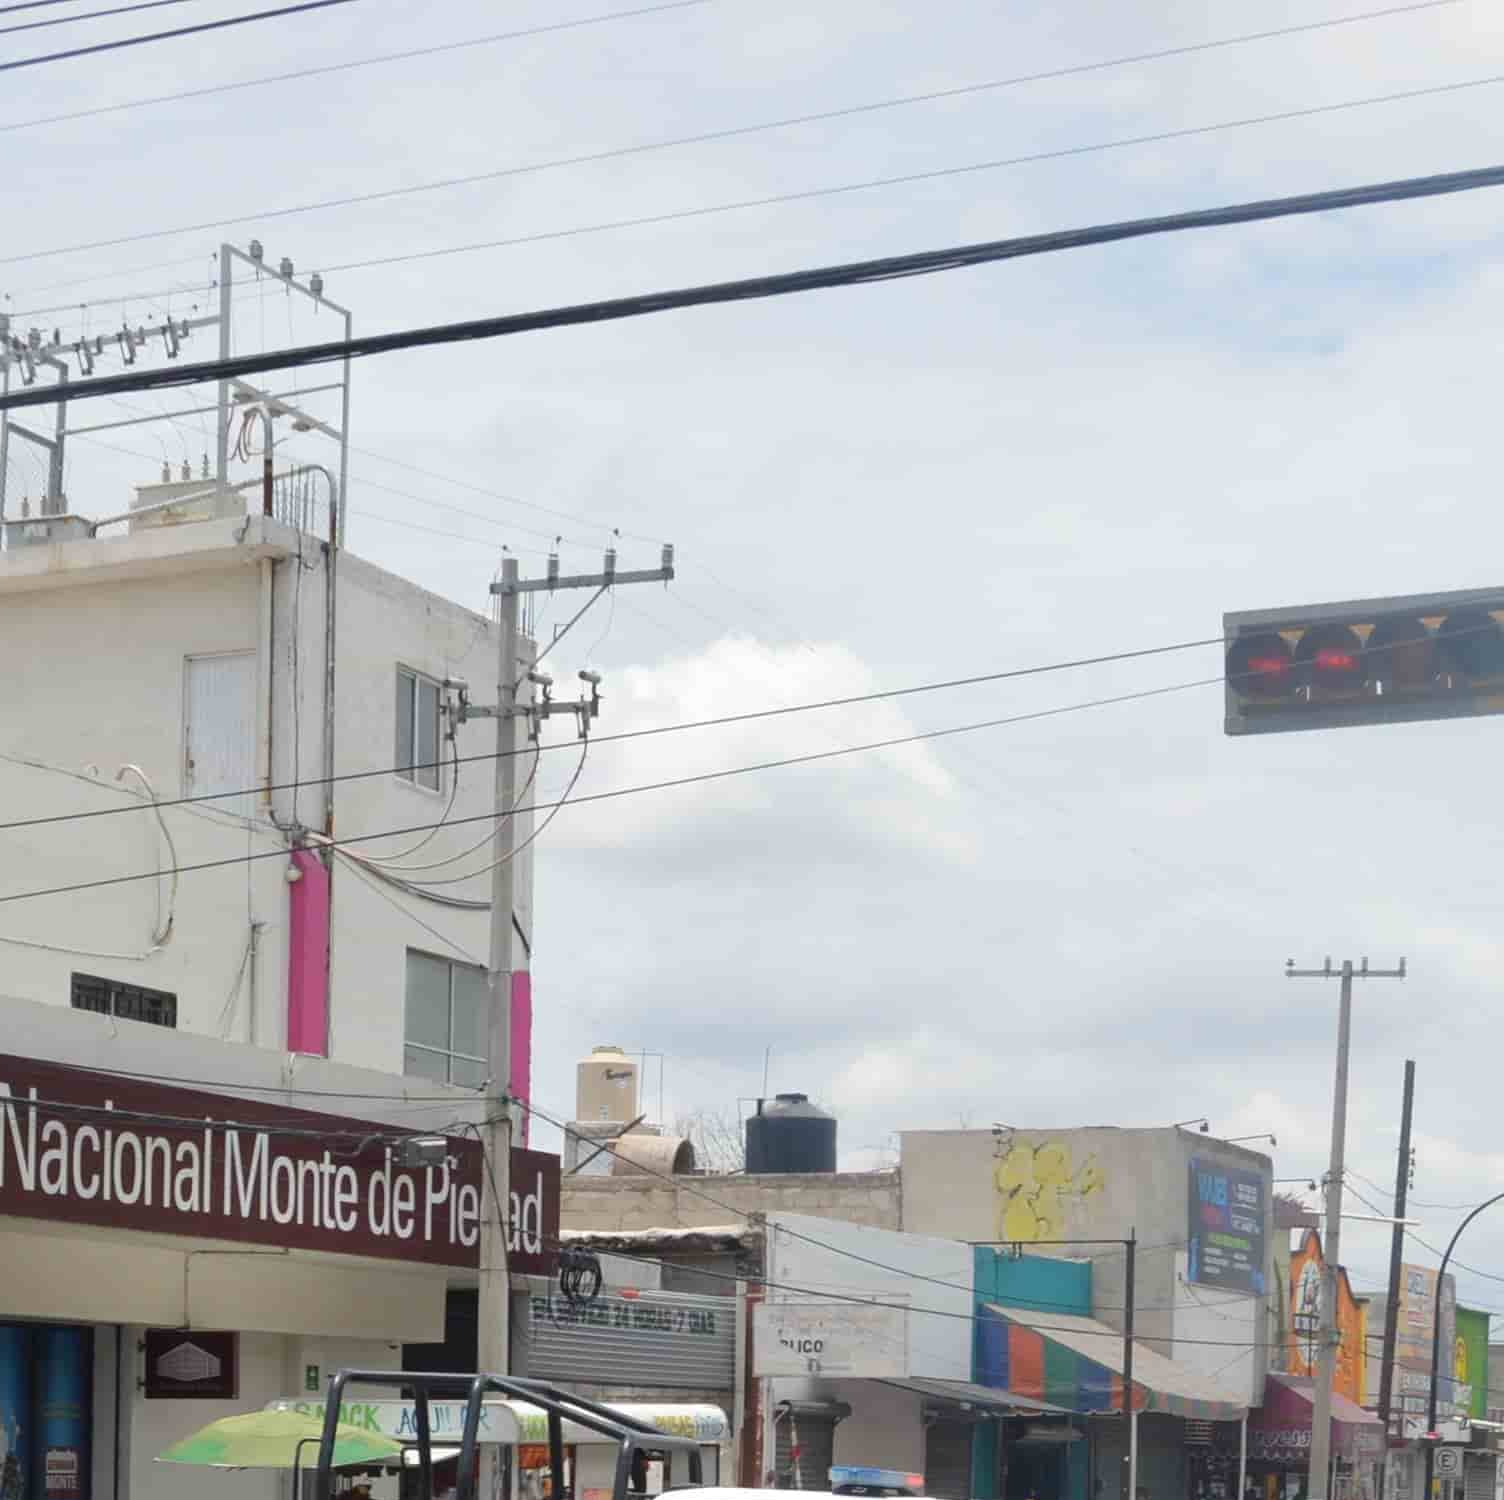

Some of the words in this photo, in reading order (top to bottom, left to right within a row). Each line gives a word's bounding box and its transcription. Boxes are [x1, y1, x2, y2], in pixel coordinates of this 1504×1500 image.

[223, 1119, 360, 1233] Monte
[368, 1146, 416, 1239] de
[423, 1154, 544, 1256] Piead
